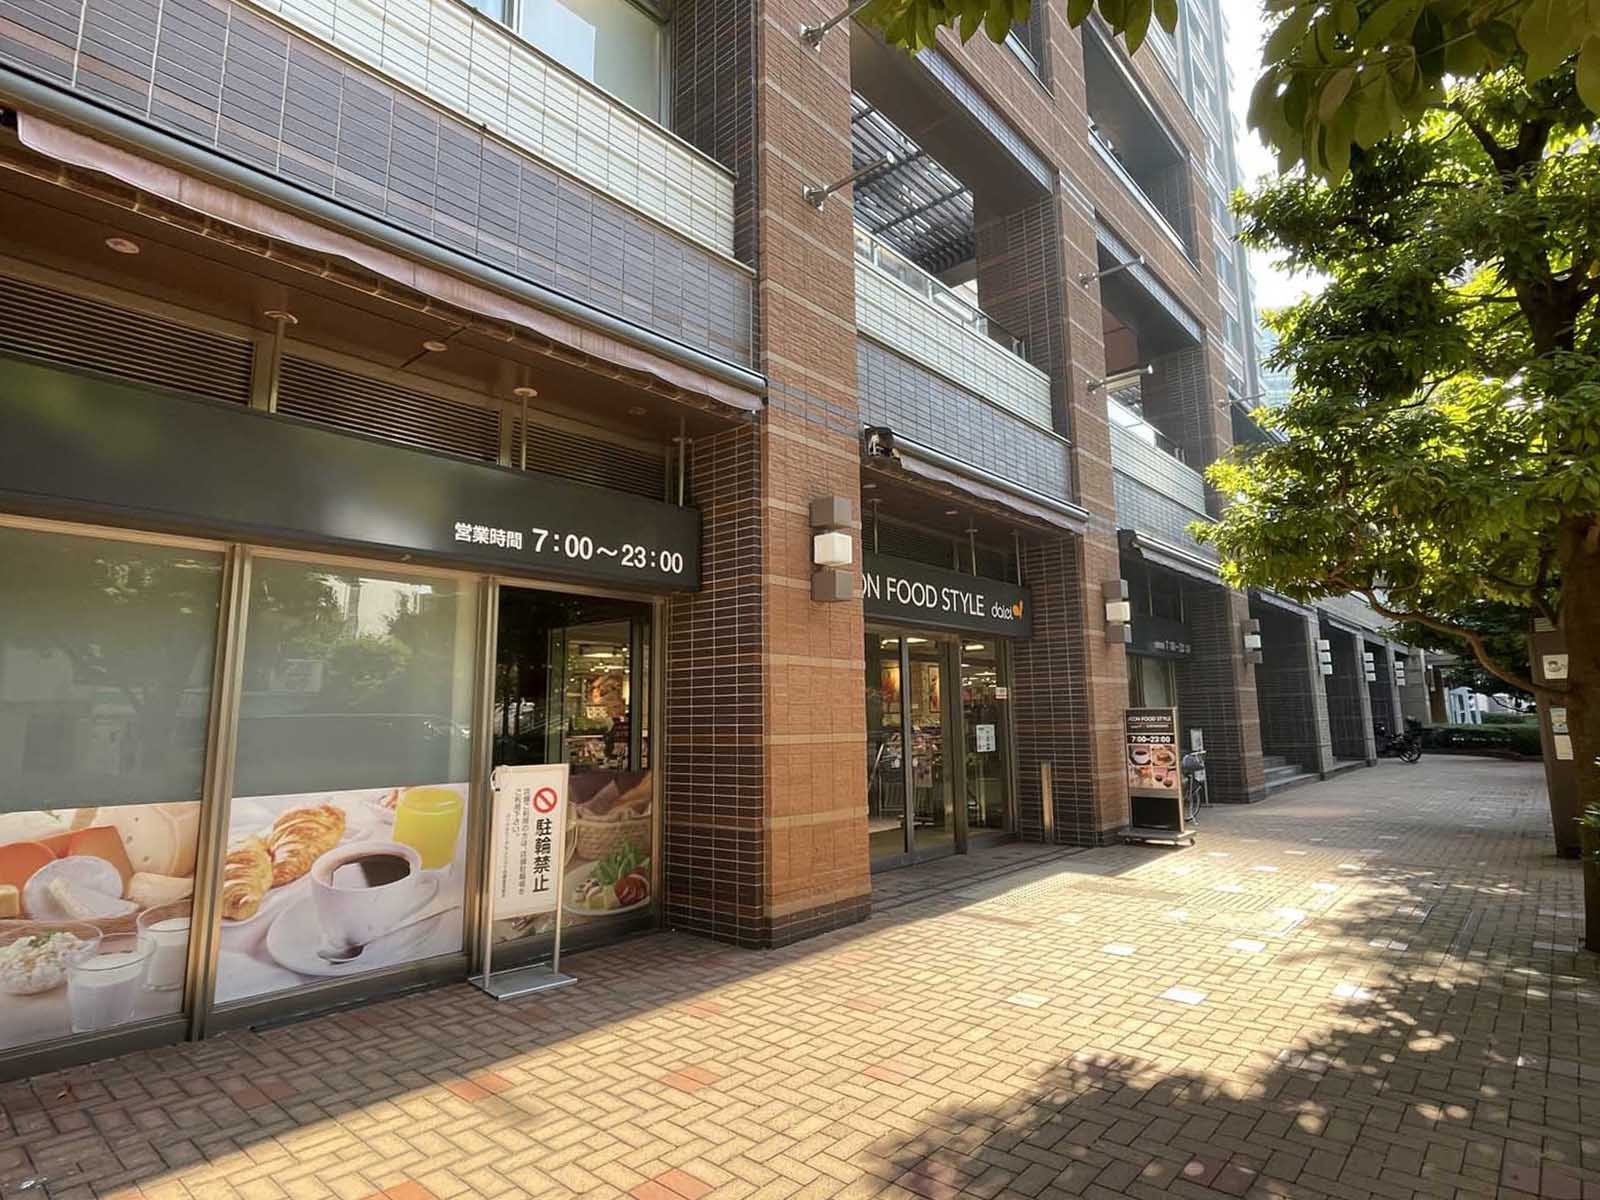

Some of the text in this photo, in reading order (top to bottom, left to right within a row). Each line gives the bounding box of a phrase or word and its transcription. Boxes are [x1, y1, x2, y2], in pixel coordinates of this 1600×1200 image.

[454, 522, 523, 550] 営業時間
[886, 577, 938, 608] FOOD
[941, 587, 986, 617] STYLE
[532, 818, 553, 893] 駐輪禁止
